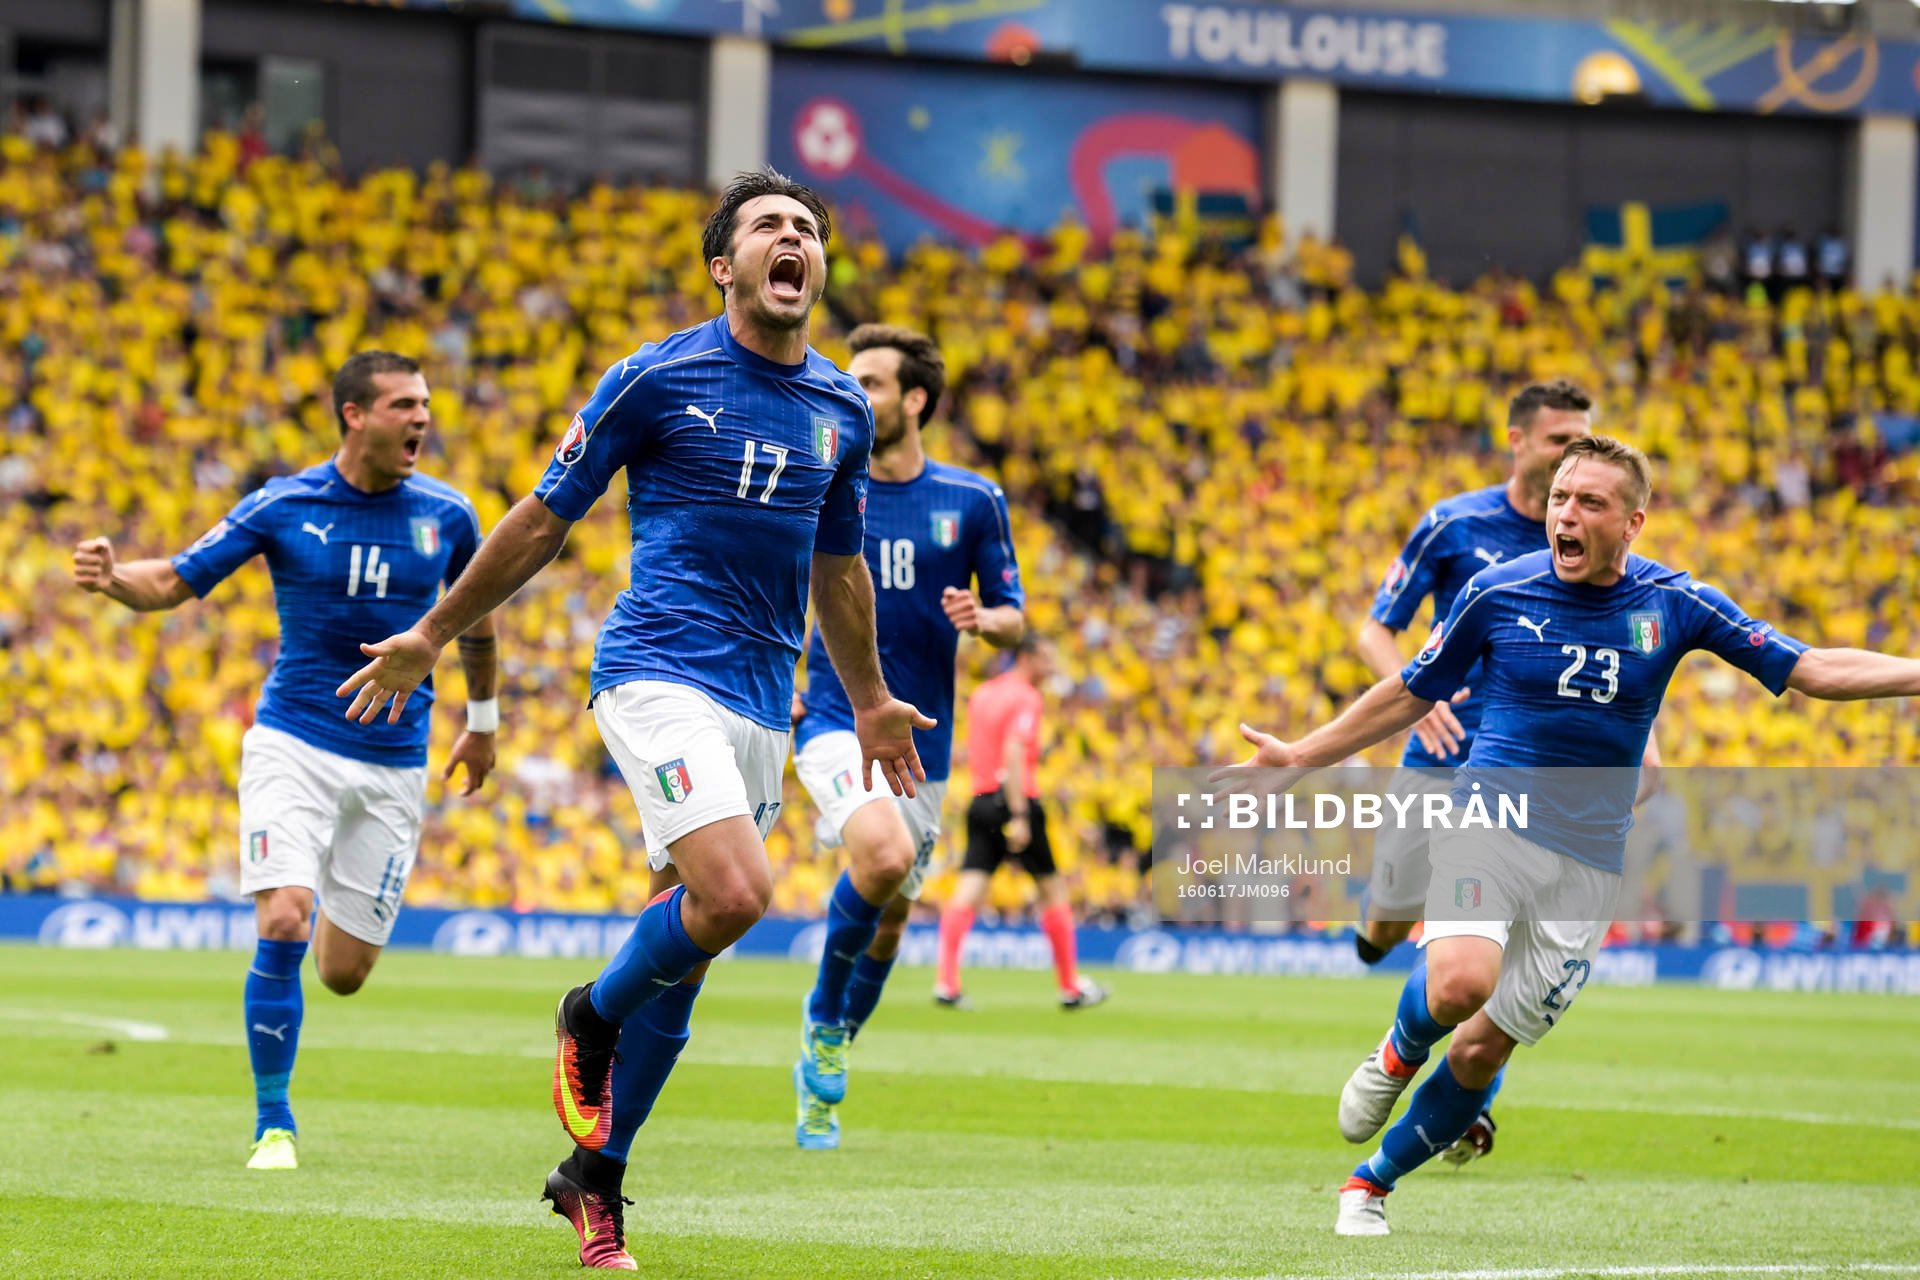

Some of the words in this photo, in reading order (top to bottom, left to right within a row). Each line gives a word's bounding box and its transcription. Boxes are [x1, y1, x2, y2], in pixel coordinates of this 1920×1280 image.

[1164, 4, 1446, 78] TOULOUSE
[737, 440, 789, 504] 17
[347, 544, 390, 598] 14
[880, 538, 916, 591] 18
[1557, 644, 1620, 704] 23
